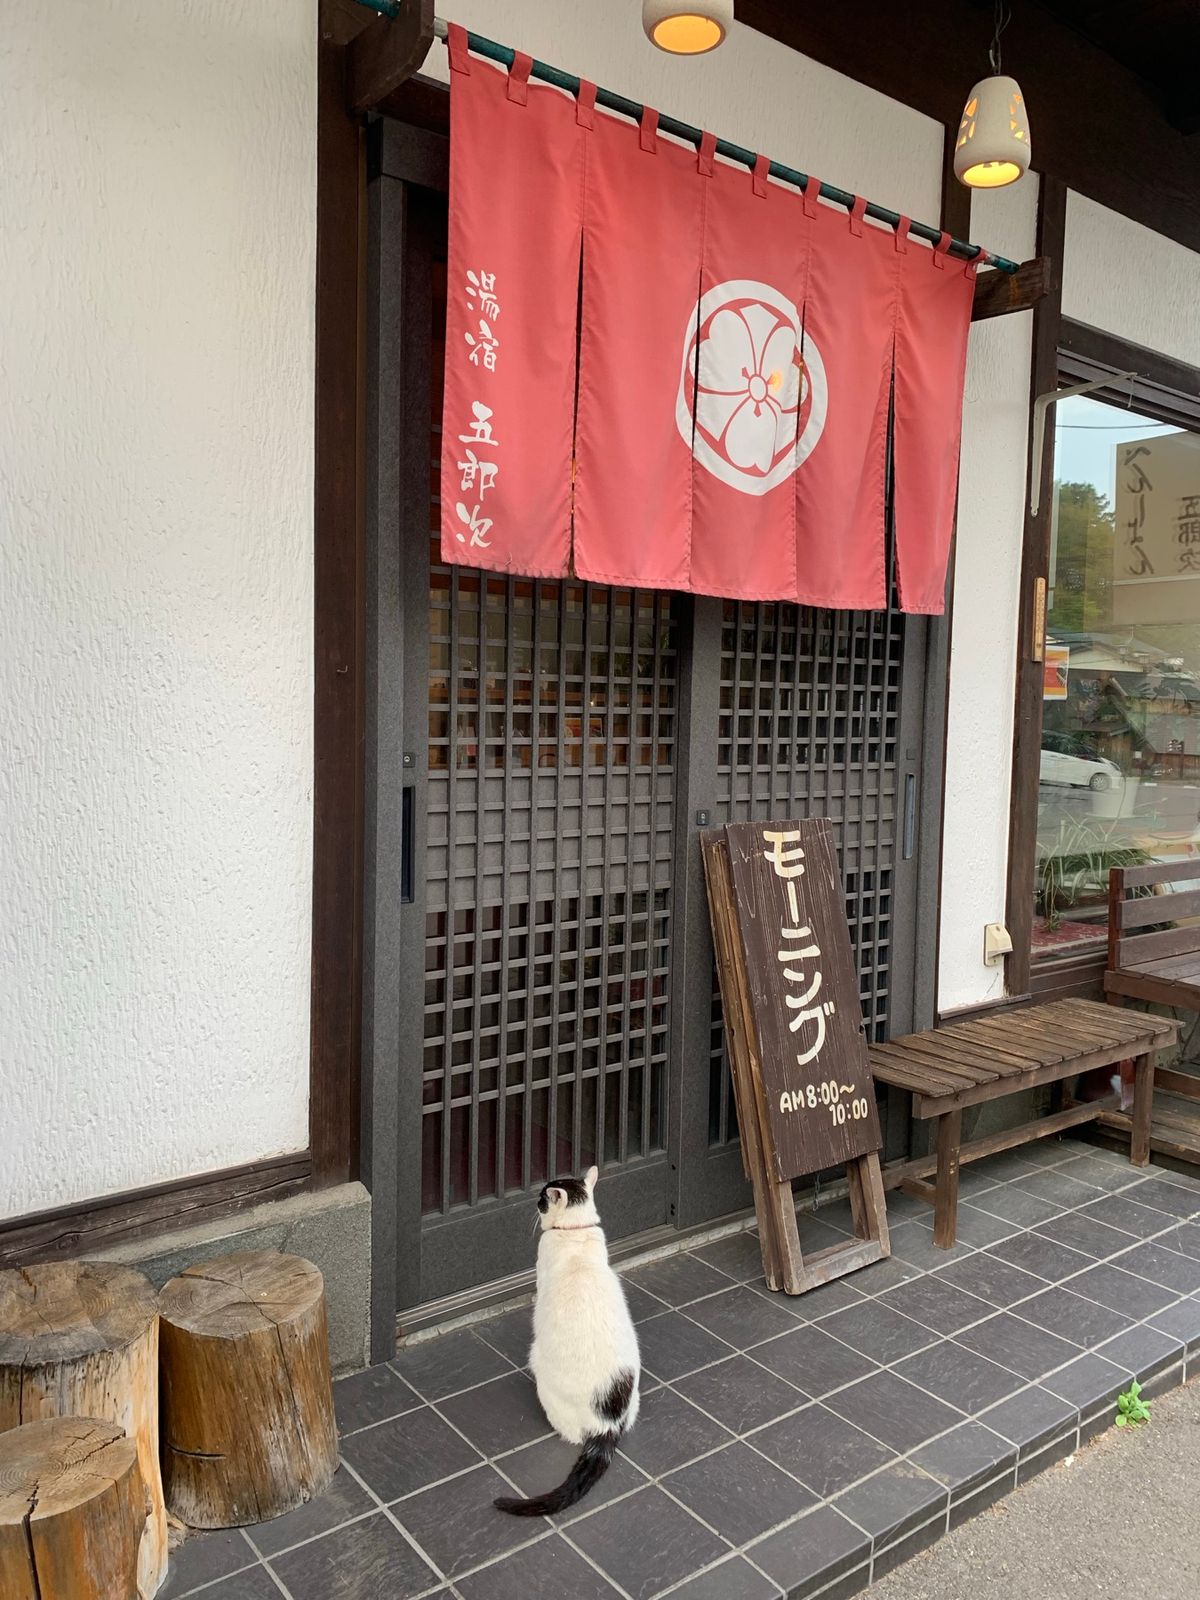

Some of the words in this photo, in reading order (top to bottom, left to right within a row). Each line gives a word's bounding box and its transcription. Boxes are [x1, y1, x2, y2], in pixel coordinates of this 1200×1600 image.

[465, 270, 500, 373] 湯宿
[455, 400, 499, 548] 五郎次
[763, 829, 836, 1066] モーニング
[829, 1098, 868, 1127] 10:00
